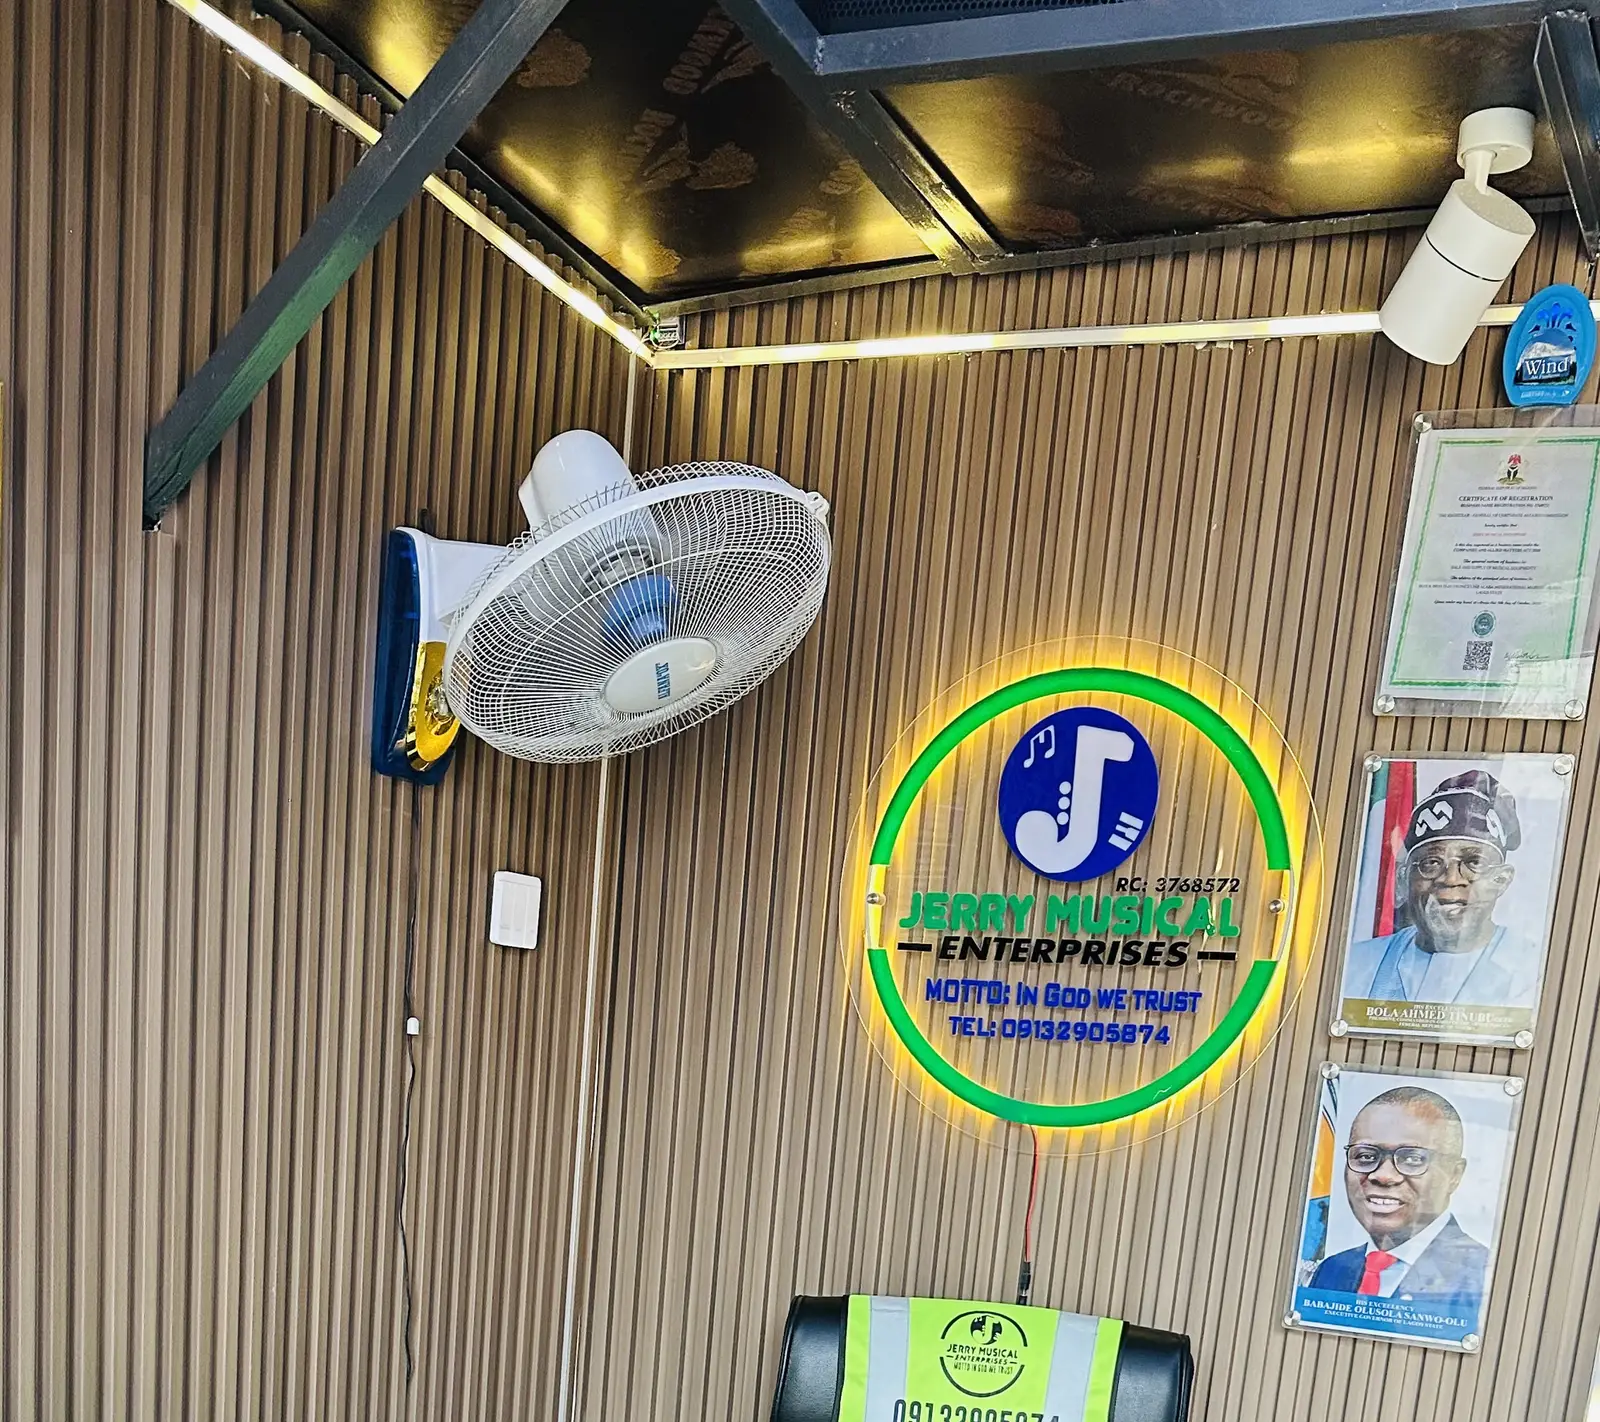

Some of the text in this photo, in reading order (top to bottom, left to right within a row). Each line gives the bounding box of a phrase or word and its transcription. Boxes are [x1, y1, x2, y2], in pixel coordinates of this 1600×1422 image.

[1525, 356, 1569, 375] Wind
[1116, 877, 1240, 893] RC: 3768572
[899, 890, 1241, 938] JERRY MUSICAL
[937, 935, 1190, 967] ENTERPRISES
[925, 978, 1011, 1005] MOTTO:
[1097, 987, 1128, 1010] WE
[1132, 989, 1203, 1013] TRUST
[1366, 1006, 1398, 1018] BOLA
[1400, 1009, 1445, 1021] AHMED
[948, 1016, 1171, 1046] TEL: 09132905874
[1303, 1298, 1469, 1328] BABAJIDE OLUSOLA SANWO-OLU
[1368, 1302, 1414, 1312] EXCELLENCY
[947, 1343, 1018, 1359] JERRY MUSICAL
[955, 1354, 1008, 1366] ENTERPRISES
